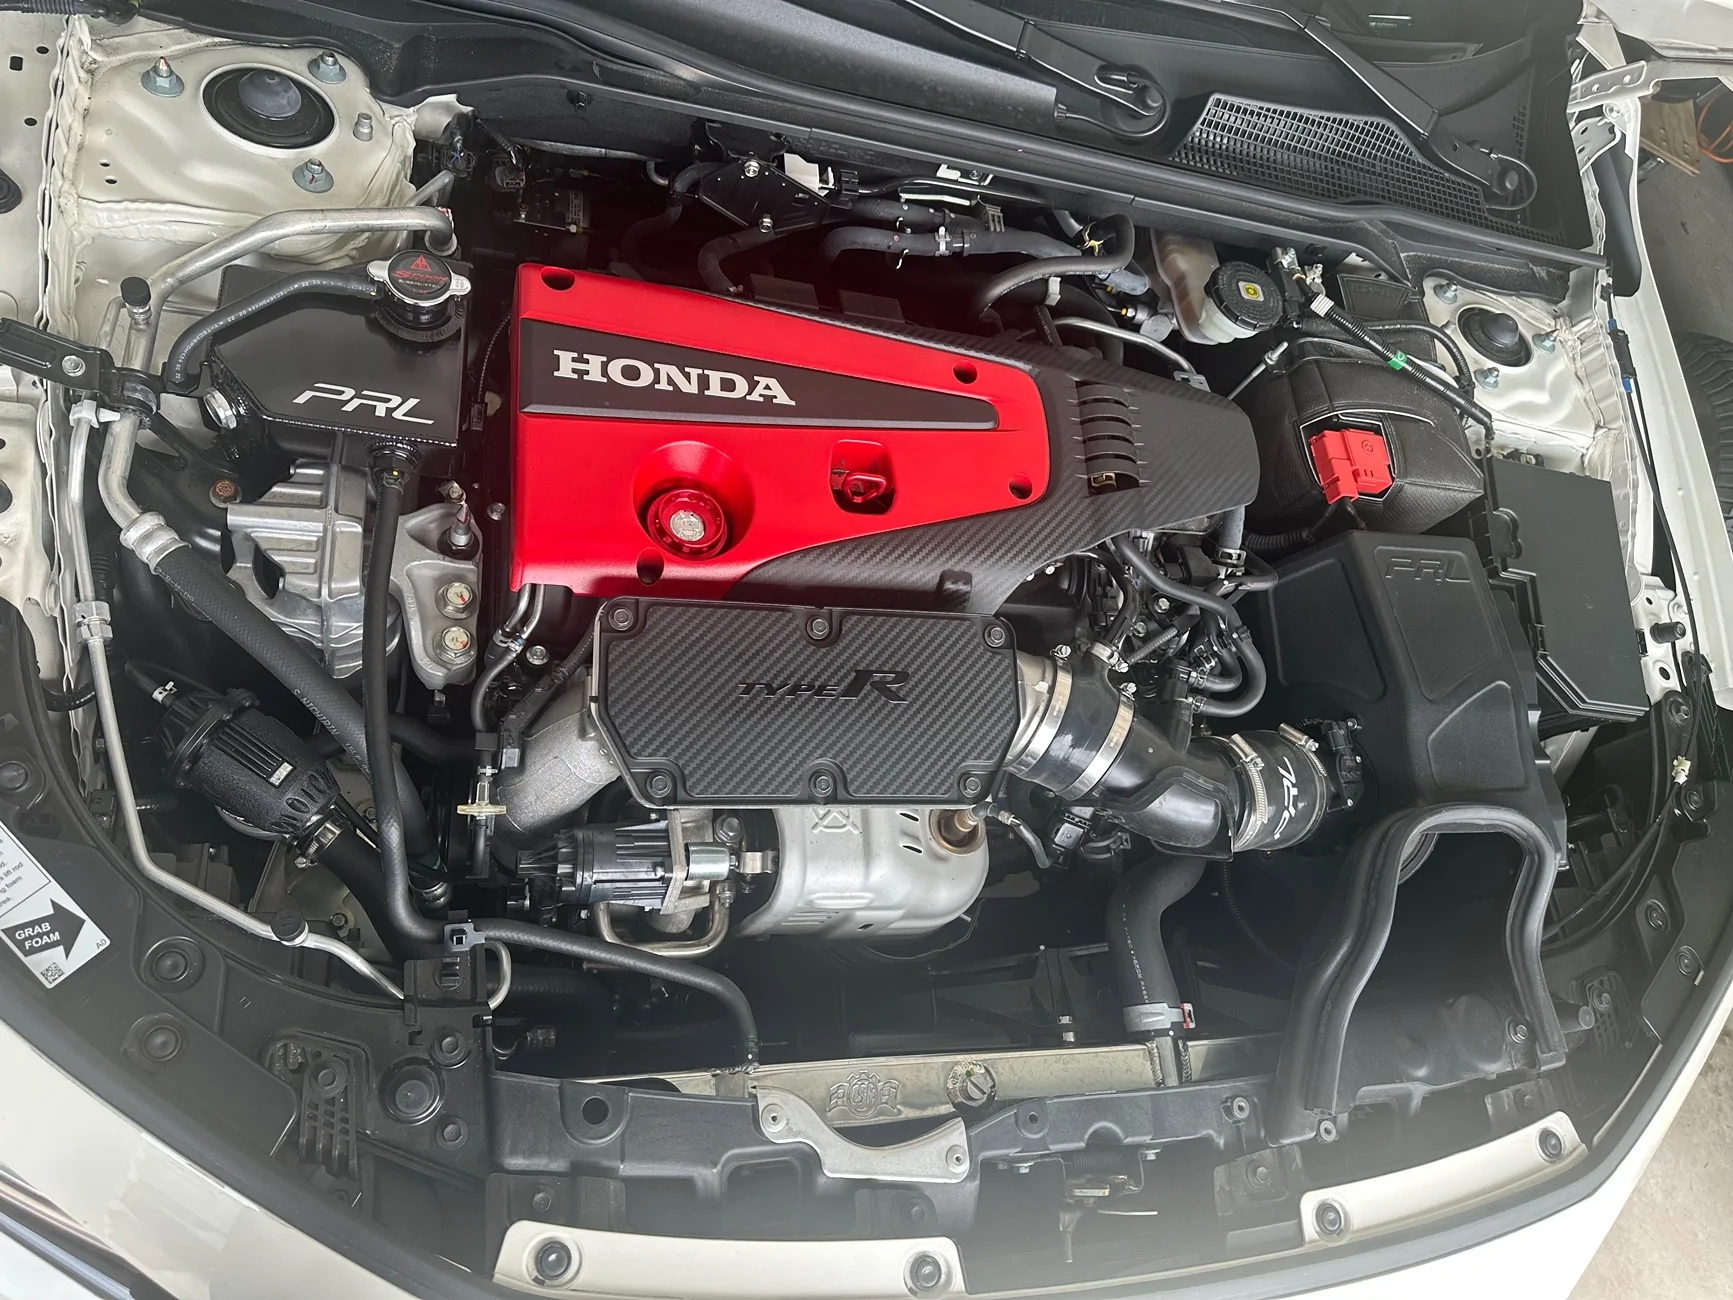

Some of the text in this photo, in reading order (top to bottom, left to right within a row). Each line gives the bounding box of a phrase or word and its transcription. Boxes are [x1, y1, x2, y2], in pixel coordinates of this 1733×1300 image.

[553, 349, 796, 406] HONDA
[291, 382, 435, 426] PRL
[1385, 557, 1471, 583] PRL
[738, 669, 911, 704] TYPE R
[300, 696, 340, 736] NICHIRIN
[1273, 755, 1299, 841] PRL
[12, 861, 24, 872] rod
[5, 875, 23, 889] foam
[15, 921, 52, 941] GRAB
[24, 931, 61, 950] FOAM
